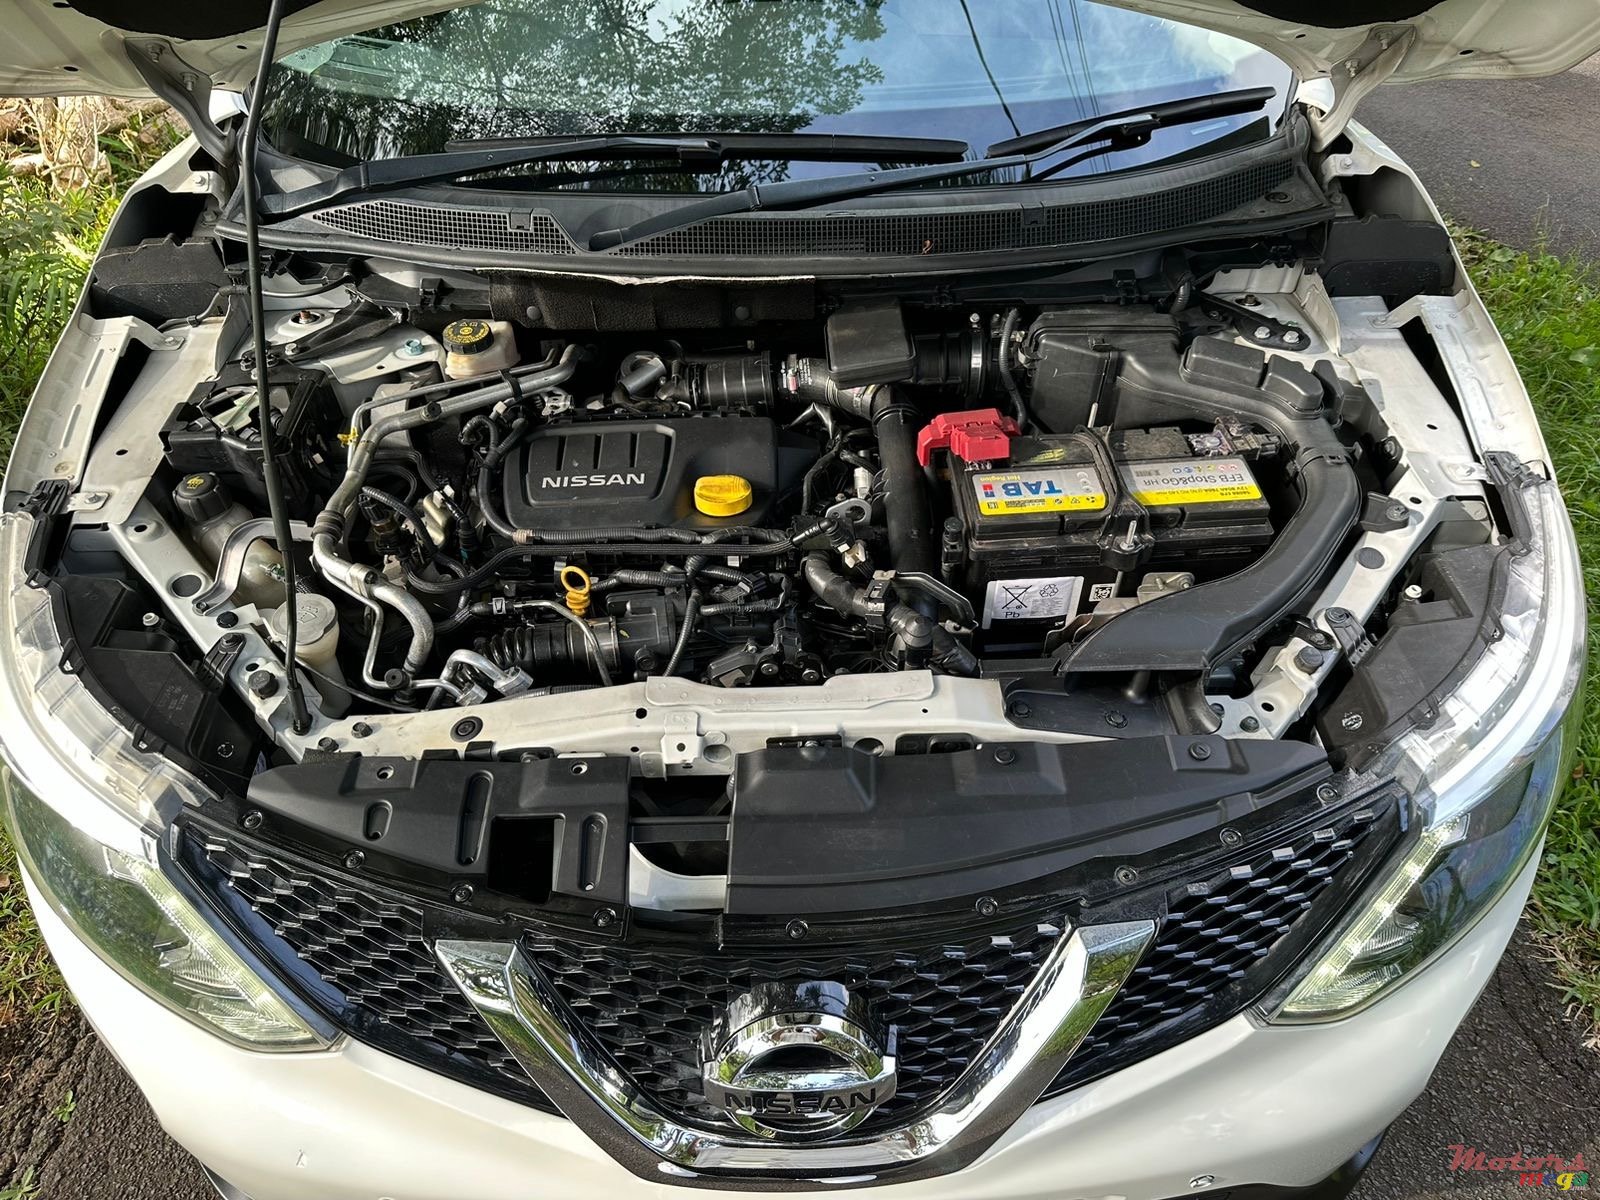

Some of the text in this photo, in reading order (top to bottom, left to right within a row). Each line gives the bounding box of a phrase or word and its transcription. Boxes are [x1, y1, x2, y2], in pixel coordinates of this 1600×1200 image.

[541, 473, 646, 489] NISSAN
[1161, 474, 1217, 486] Stop&Go
[1219, 473, 1245, 483] EFB
[1001, 480, 1063, 497] TAB
[724, 1087, 877, 1114] NISSAN
